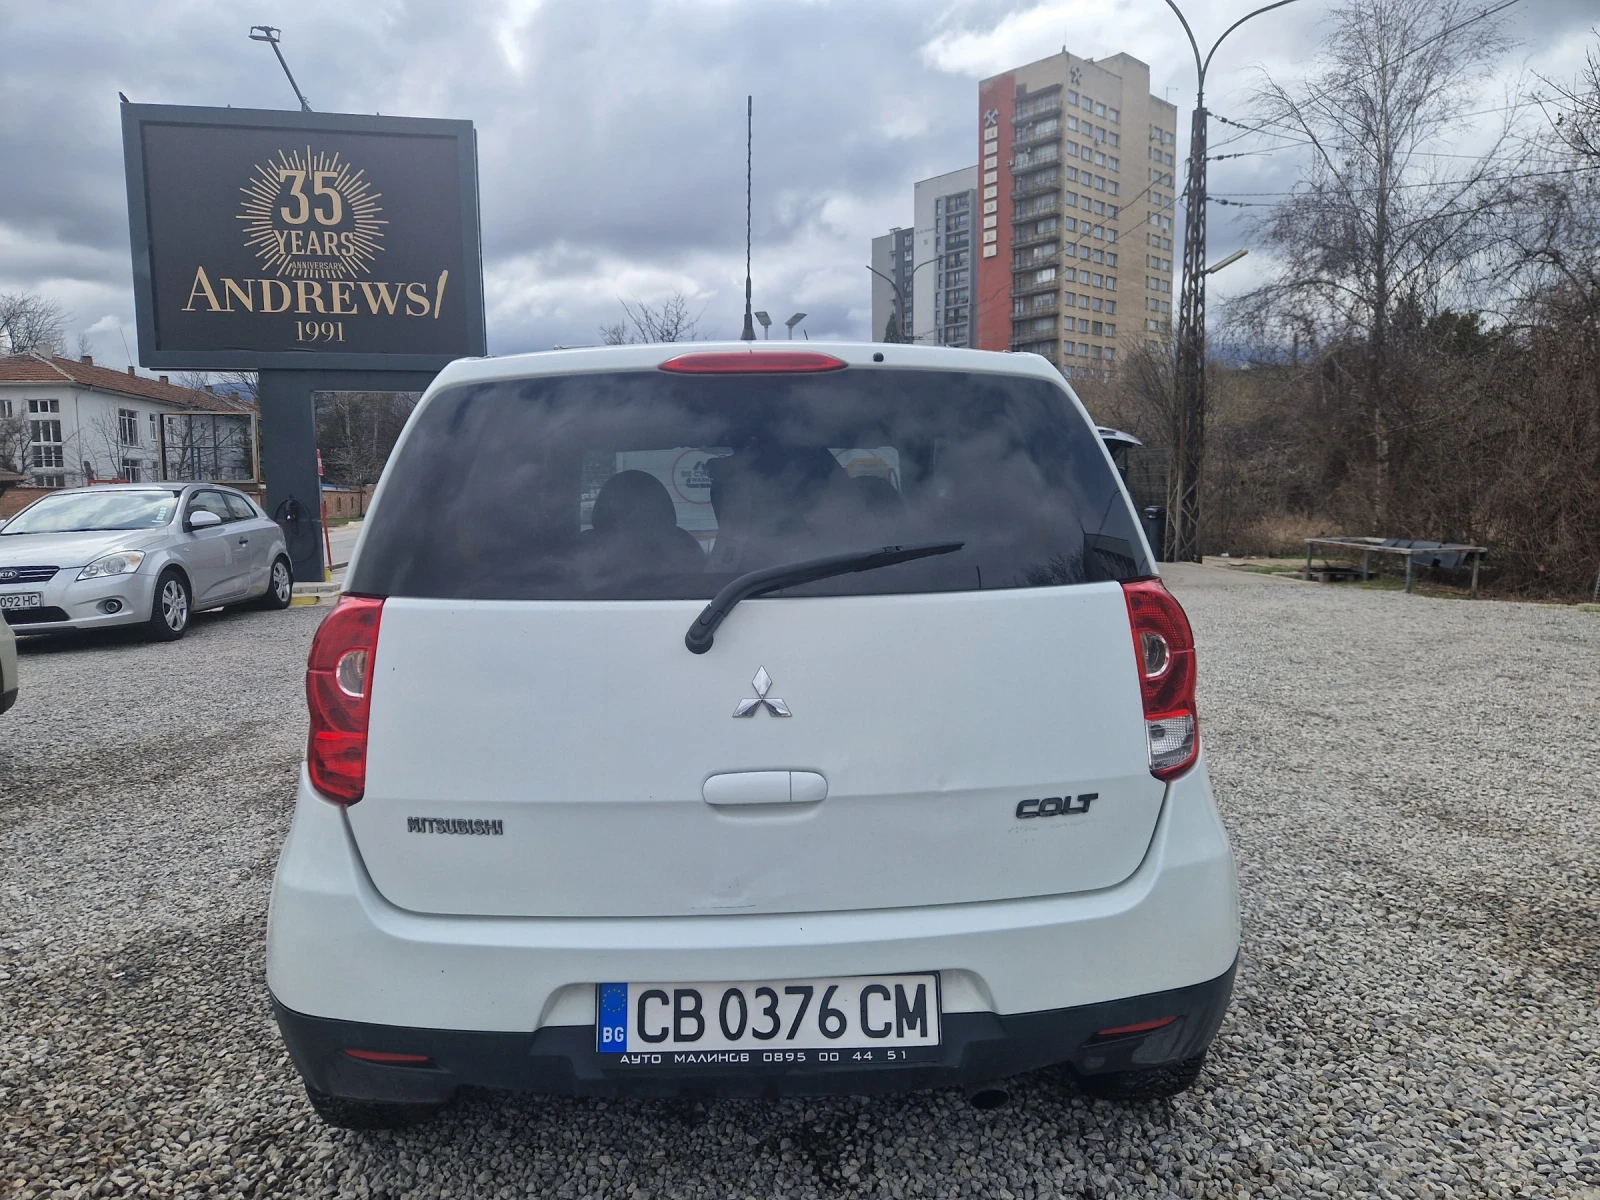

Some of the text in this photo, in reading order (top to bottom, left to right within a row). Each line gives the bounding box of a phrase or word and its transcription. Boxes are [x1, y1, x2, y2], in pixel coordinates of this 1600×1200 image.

[279, 169, 343, 226] 35
[273, 229, 355, 257] YEARS
[291, 261, 343, 270] ANNIVERSARY
[295, 321, 346, 342] 1991
[1015, 792, 1099, 819] COLT
[407, 816, 504, 836] MITSUBISHI
[637, 983, 928, 1043] CB 0376 CM
[602, 1027, 625, 1043] BG
[620, 1054, 662, 1064] АУТО
[762, 1052, 807, 1062] 0895
[818, 1052, 839, 1061] 00
[852, 1051, 874, 1061] 44
[887, 1050, 907, 1060] 51
